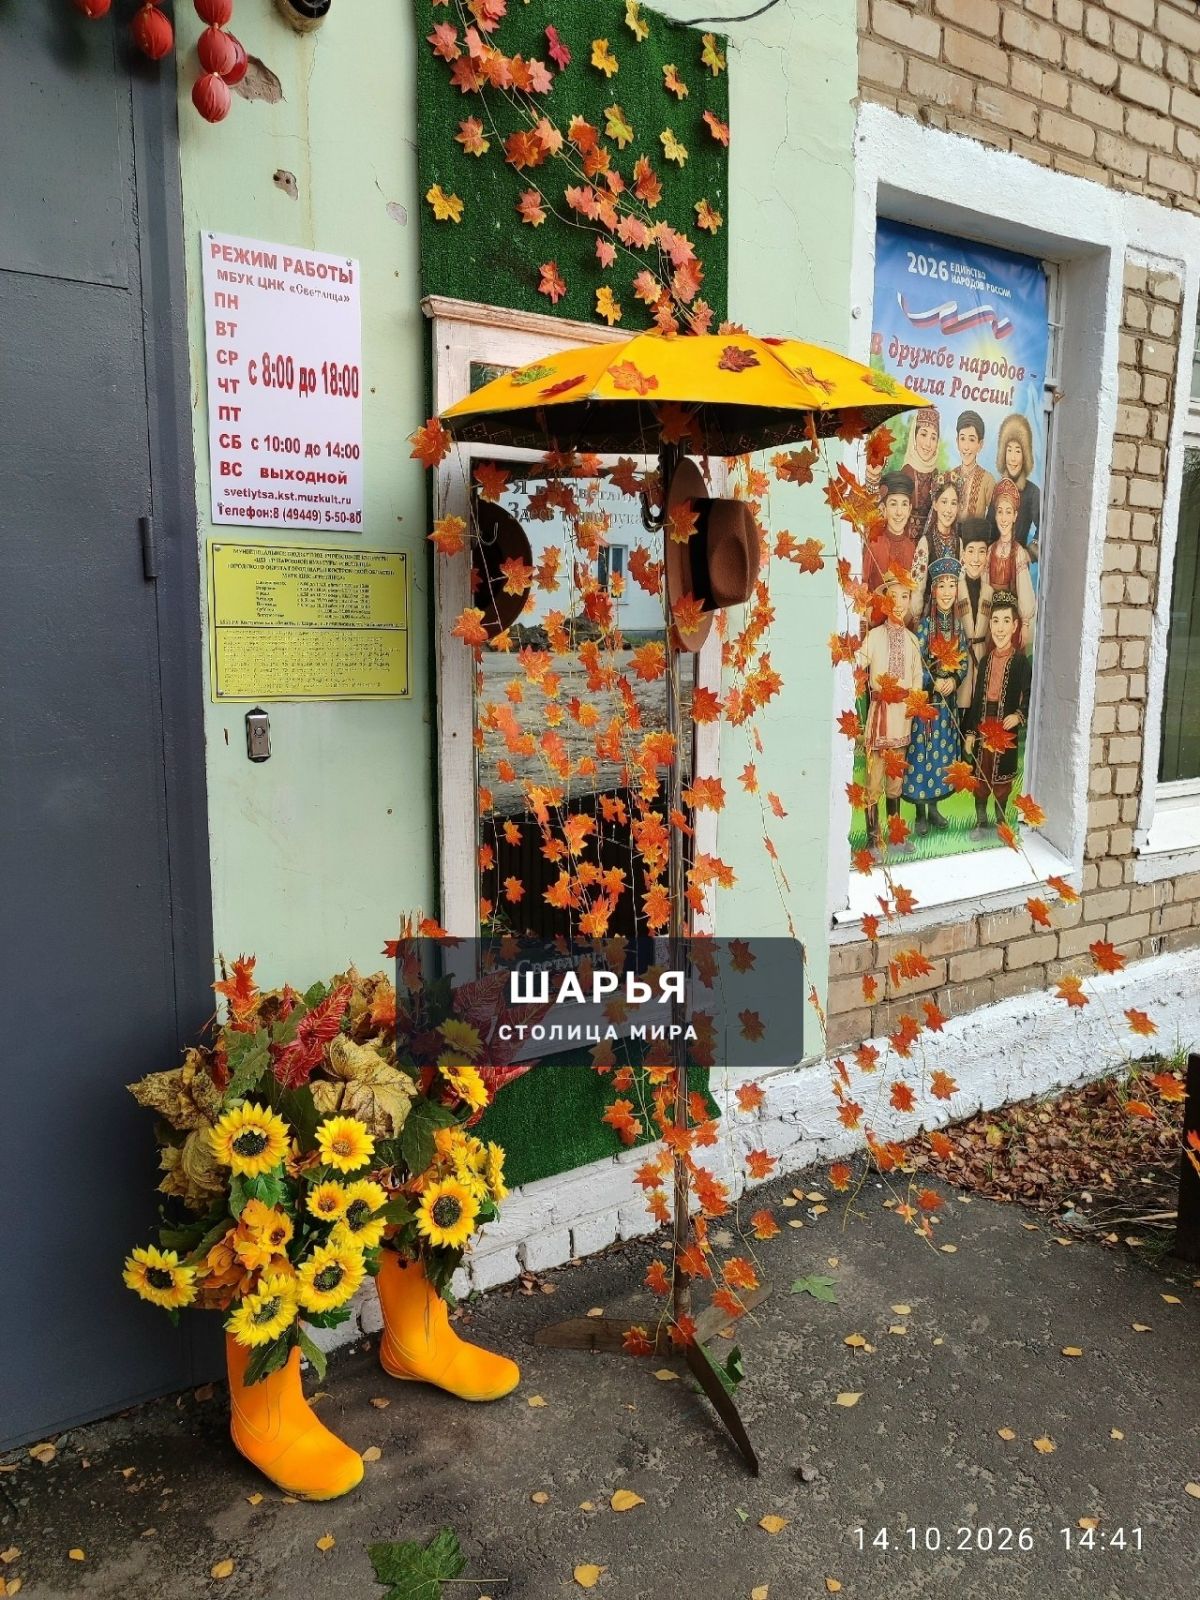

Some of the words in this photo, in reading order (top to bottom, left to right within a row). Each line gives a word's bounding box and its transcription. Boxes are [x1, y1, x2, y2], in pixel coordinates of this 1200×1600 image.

[211, 243, 277, 270] РЕЖИМ
[282, 256, 353, 284] РАБОТЫ
[907, 252, 949, 281] 2026
[217, 269, 254, 286] МБУК
[258, 277, 285, 291] ЦНК
[952, 275, 985, 291] НАРОДОВ
[986, 282, 1012, 299] РОССИИ
[214, 292, 239, 309] ПН
[215, 320, 238, 338] ВТ
[216, 349, 239, 366] СР
[889, 335, 954, 369] дружбе
[959, 355, 1025, 381] народов
[217, 377, 240, 394] ЧТ
[262, 351, 294, 390] 8:00
[299, 365, 317, 398] до
[321, 361, 359, 399] 18:00
[904, 375, 945, 396] сила
[949, 376, 1014, 406] России!
[218, 405, 242, 422] ПТ
[219, 433, 242, 450] СБ
[263, 434, 301, 455] 10:00
[305, 441, 320, 458] до
[325, 441, 360, 460] 14:00
[220, 461, 243, 477] ВС
[260, 466, 347, 485] выходной
[283, 507, 322, 523] (49449)
[325, 510, 362, 524] 5-50-80
